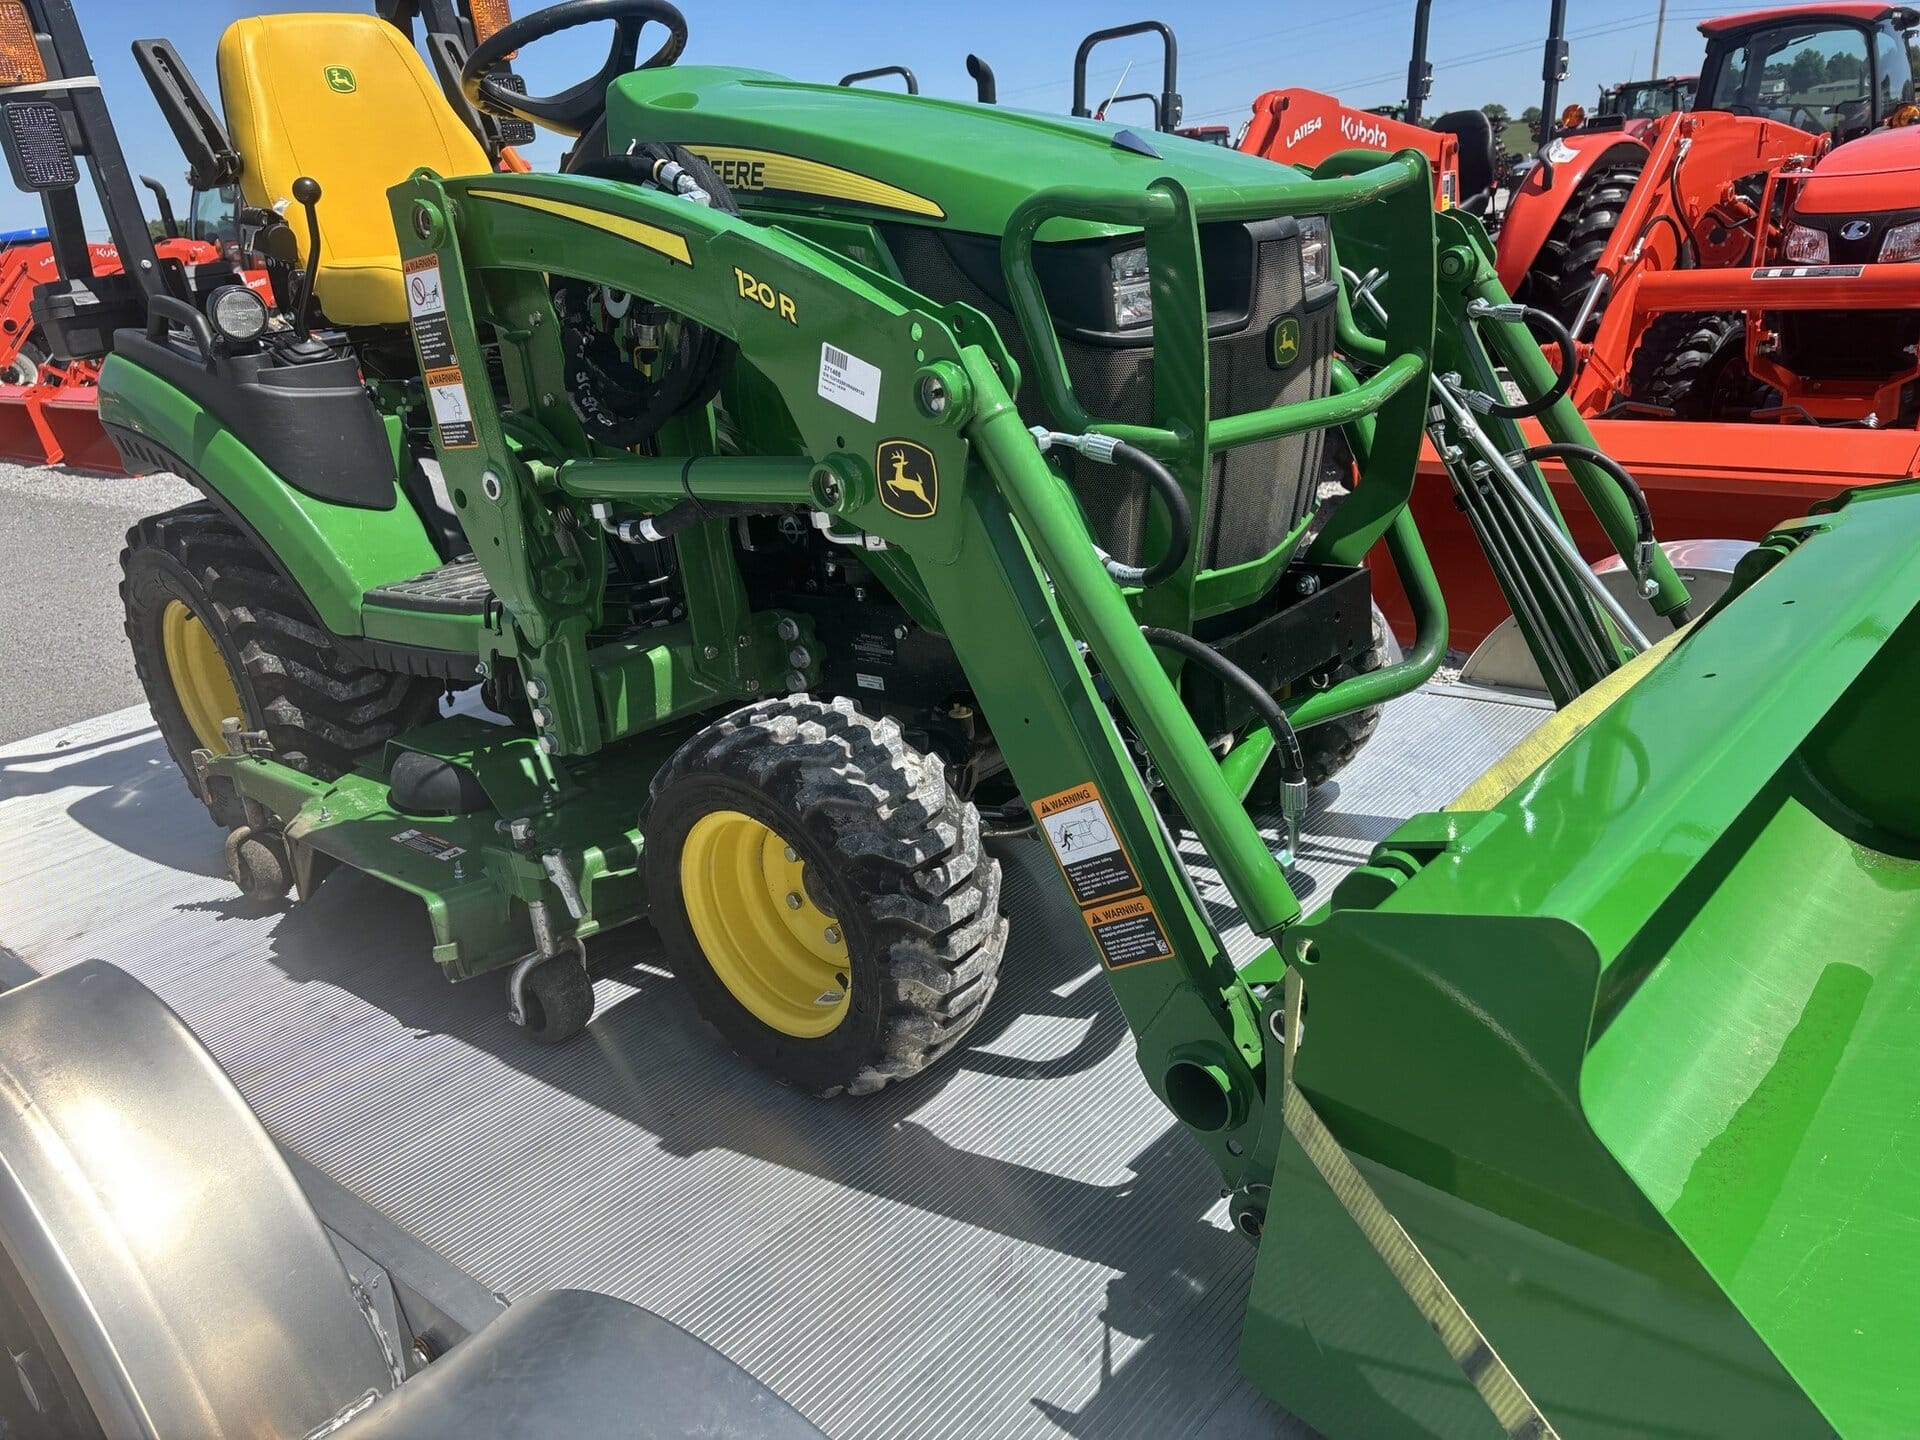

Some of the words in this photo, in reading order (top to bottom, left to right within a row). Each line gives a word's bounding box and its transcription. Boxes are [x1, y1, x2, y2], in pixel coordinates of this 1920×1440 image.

[1286, 117, 1322, 149] LA1154
[1341, 115, 1387, 148] Kubota
[410, 256, 437, 270] WARNING
[433, 372, 462, 385] WARNING
[1049, 789, 1091, 811] WARNING
[1102, 902, 1145, 920] WARNING
